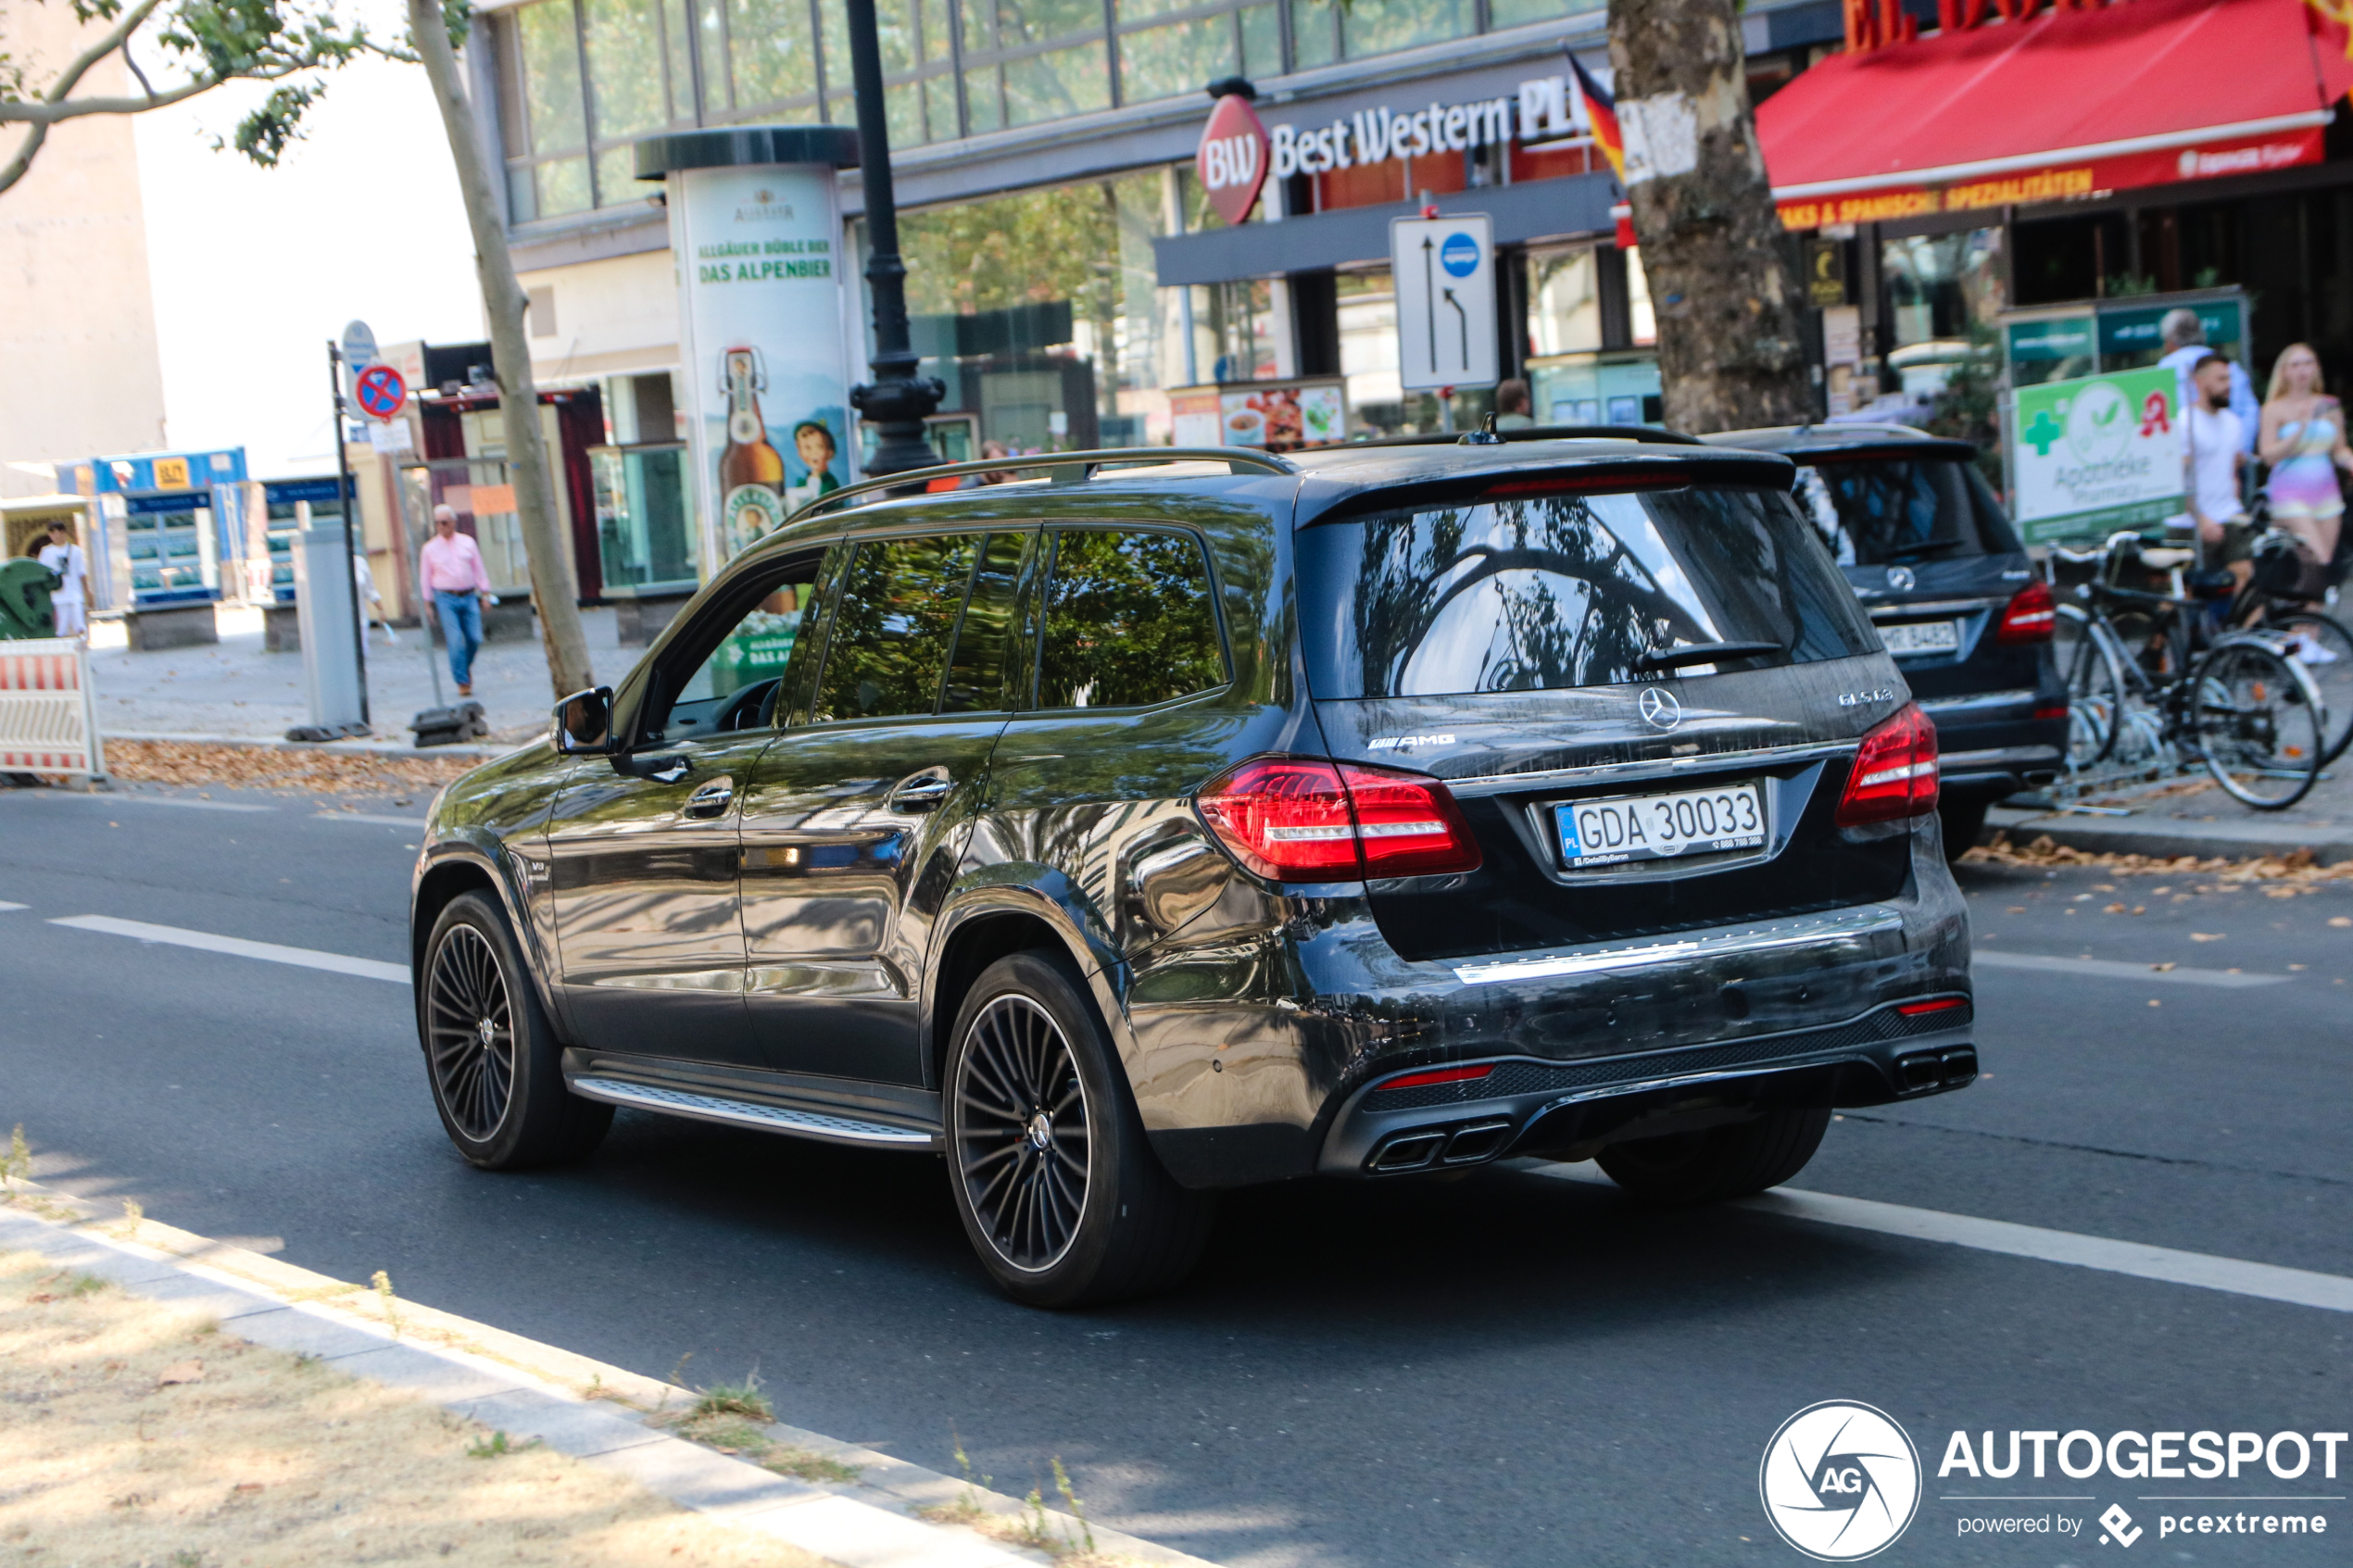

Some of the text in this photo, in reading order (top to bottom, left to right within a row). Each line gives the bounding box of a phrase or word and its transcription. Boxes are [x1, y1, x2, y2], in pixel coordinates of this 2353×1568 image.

[1273, 119, 1352, 179] Best
[1353, 97, 1512, 165] Western
[1206, 132, 1257, 190] BW
[1946, 168, 2093, 213] SPEZIALITÄTEN
[699, 258, 830, 284] DAS ALPENBIER
[1400, 734, 1455, 746] AMG
[1566, 838, 1579, 848] PL
[1579, 792, 1757, 849] GDA 30033
